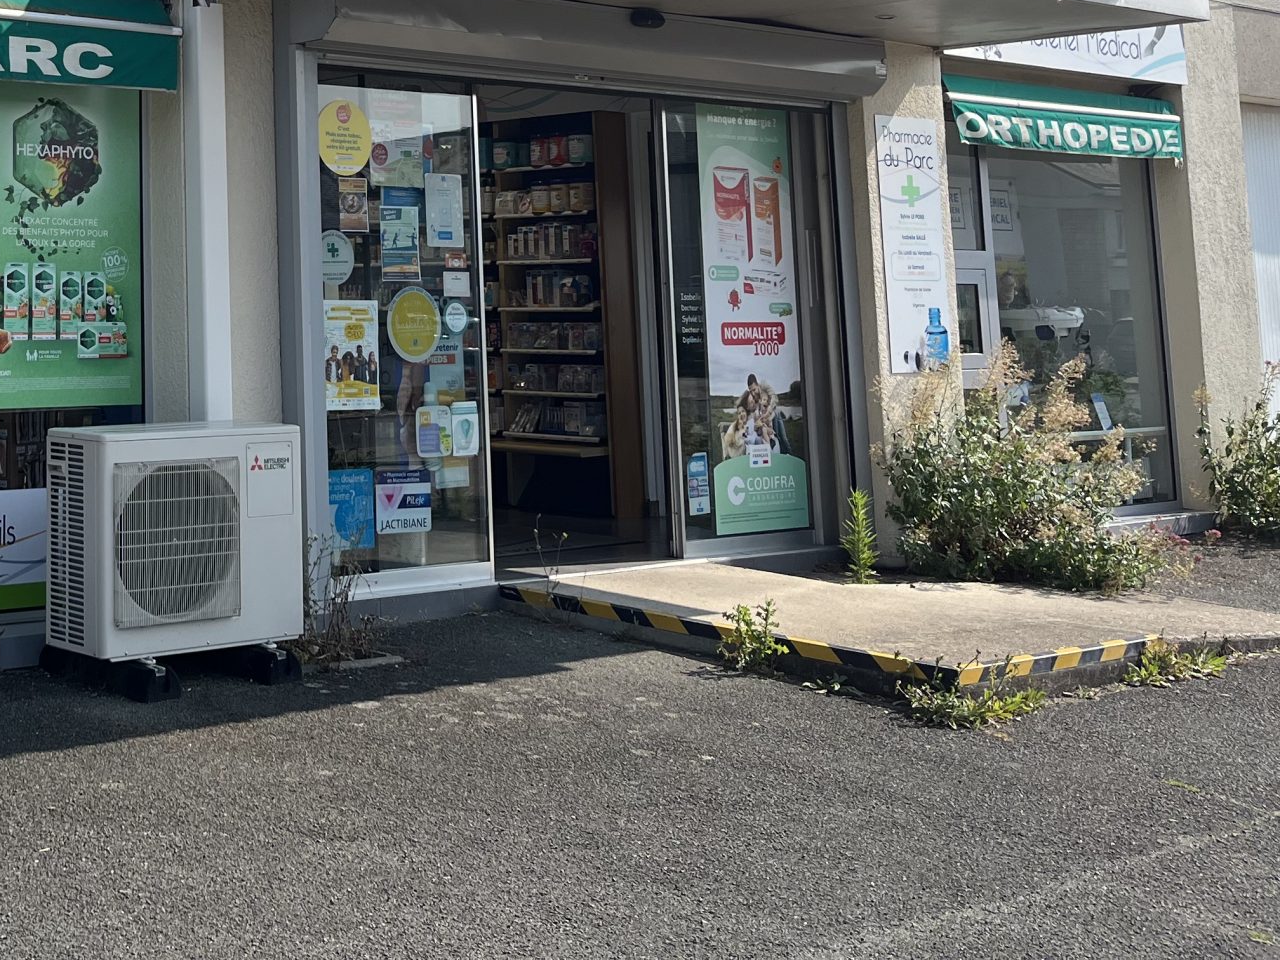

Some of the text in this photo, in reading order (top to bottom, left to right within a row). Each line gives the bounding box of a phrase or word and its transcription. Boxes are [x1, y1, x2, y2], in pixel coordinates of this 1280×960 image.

[882, 125, 933, 146] Pharmacie
[954, 111, 1180, 154] ORTHOPEDIE
[16, 143, 94, 160] HEXAPHYTO
[884, 145, 934, 170] du Parc
[2, 226, 109, 238] DES BIENFAITS PHYTO POUR
[16, 238, 25, 247] LA
[27, 239, 48, 247] TOUX
[58, 240, 67, 248] LA
[68, 239, 96, 248] GORGE
[753, 341, 780, 356] 1000
[747, 475, 796, 491] CODIFRA
[380, 518, 428, 532] LACTIBIANE
